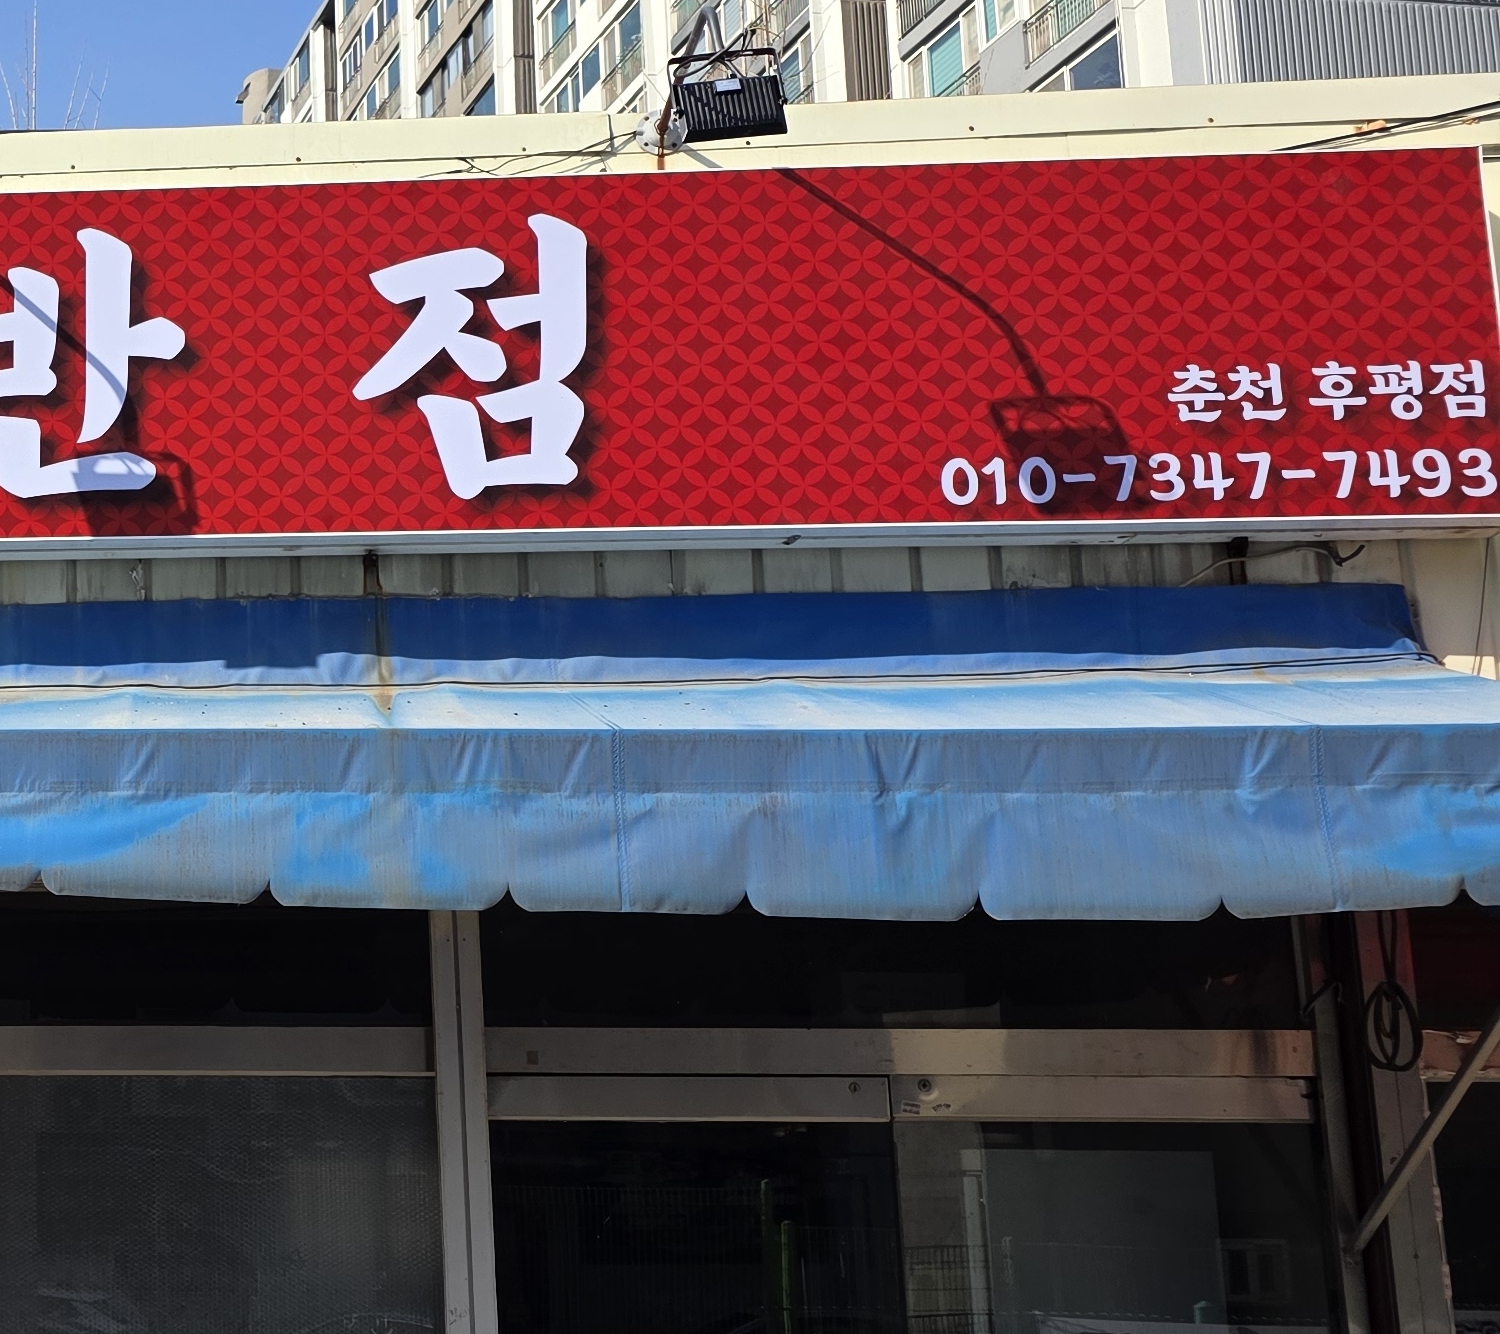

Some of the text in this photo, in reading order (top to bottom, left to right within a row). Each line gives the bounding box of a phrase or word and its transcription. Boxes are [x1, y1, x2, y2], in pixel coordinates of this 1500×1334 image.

[1167, 359, 1487, 423] 춘천 후평점
[940, 448, 1498, 506] 010-7347-7493
